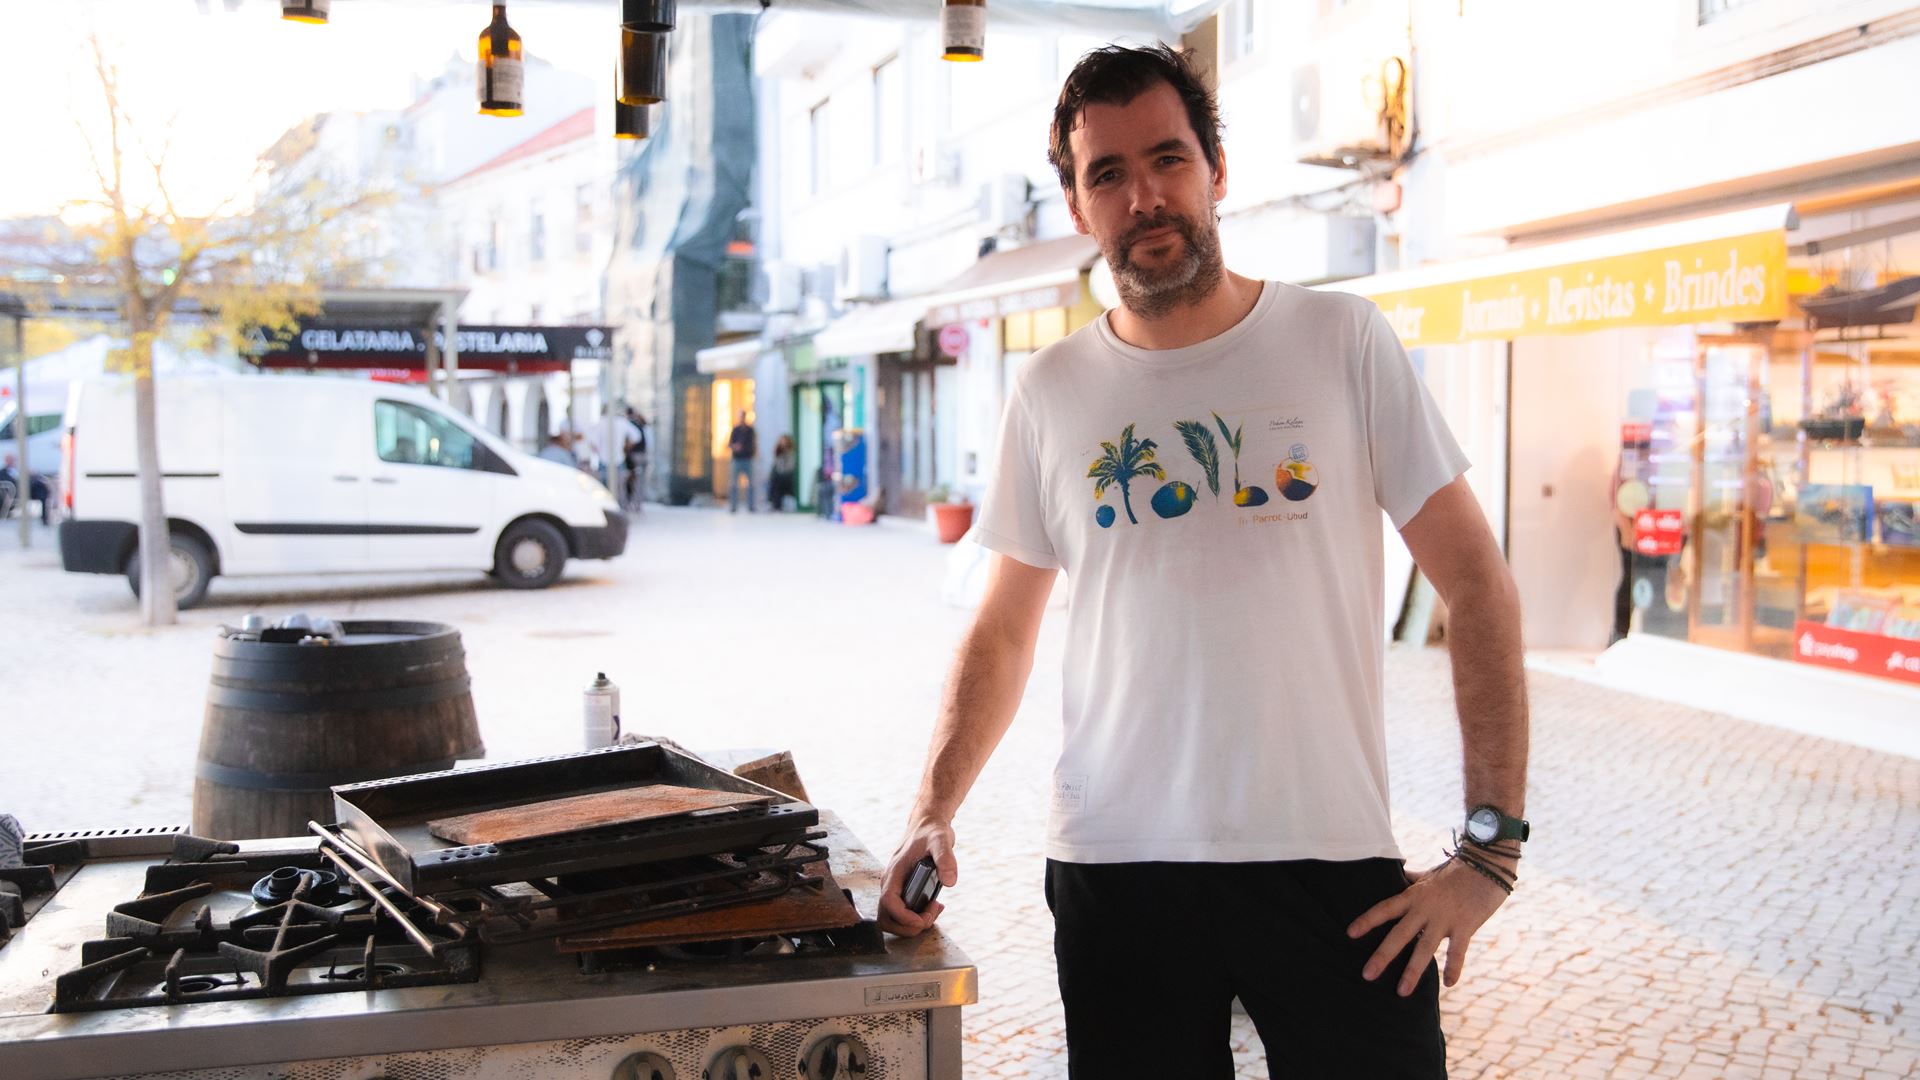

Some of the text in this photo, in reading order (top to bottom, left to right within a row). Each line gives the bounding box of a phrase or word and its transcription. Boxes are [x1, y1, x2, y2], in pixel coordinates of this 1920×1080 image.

[1458, 282, 1526, 341] Jornais
[1546, 273, 1636, 326] Revistas
[1662, 248, 1767, 314] Brindes
[301, 329, 416, 351] GELATARIA
